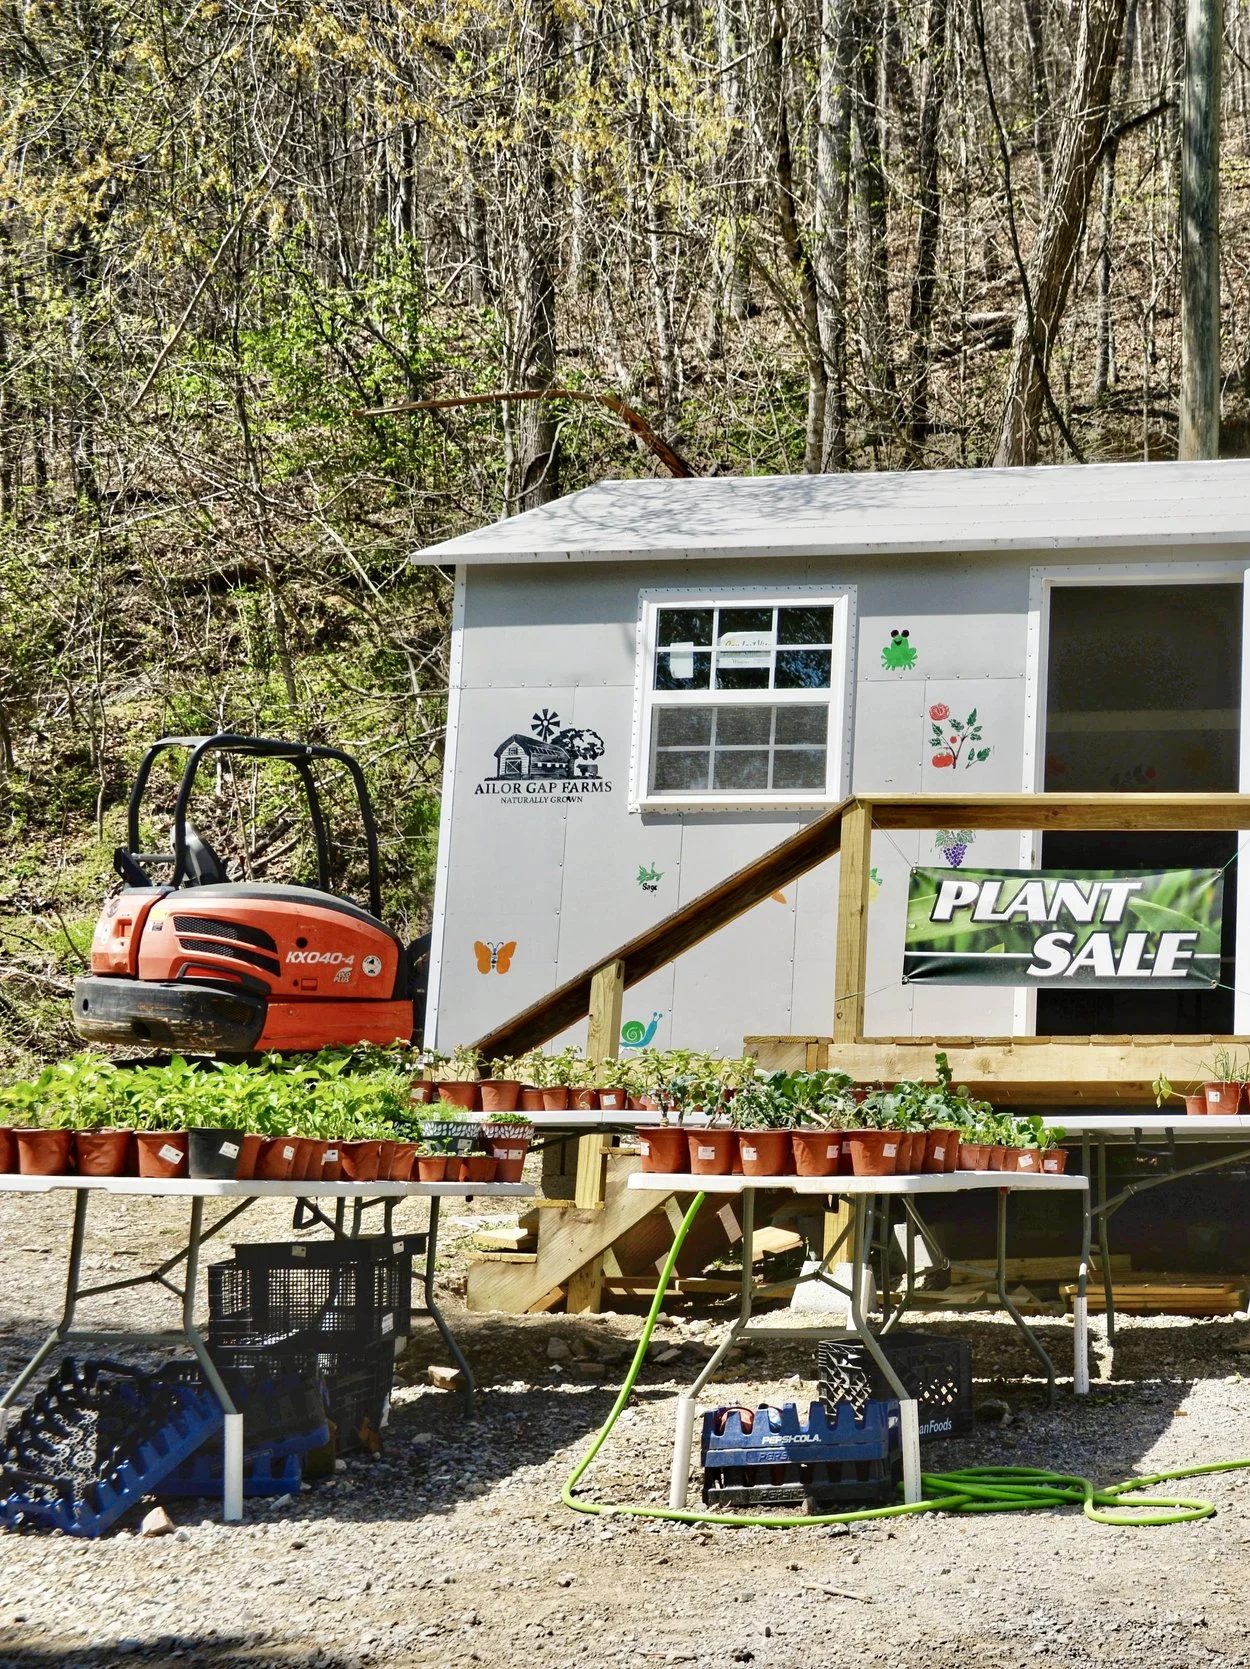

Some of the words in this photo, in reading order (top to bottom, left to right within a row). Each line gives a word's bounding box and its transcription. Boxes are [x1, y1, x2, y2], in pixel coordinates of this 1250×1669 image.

[474, 783, 522, 794] AILOR
[526, 782, 557, 794] GAP
[562, 781, 612, 793] FARMS
[500, 796, 549, 804] NATURALLY
[642, 882, 658, 892] Sage
[931, 880, 1142, 922] PLANT
[285, 951, 355, 965] KX040-4
[1026, 932, 1198, 977] SALE
[761, 1434, 821, 1445] PEPSI-COLA
